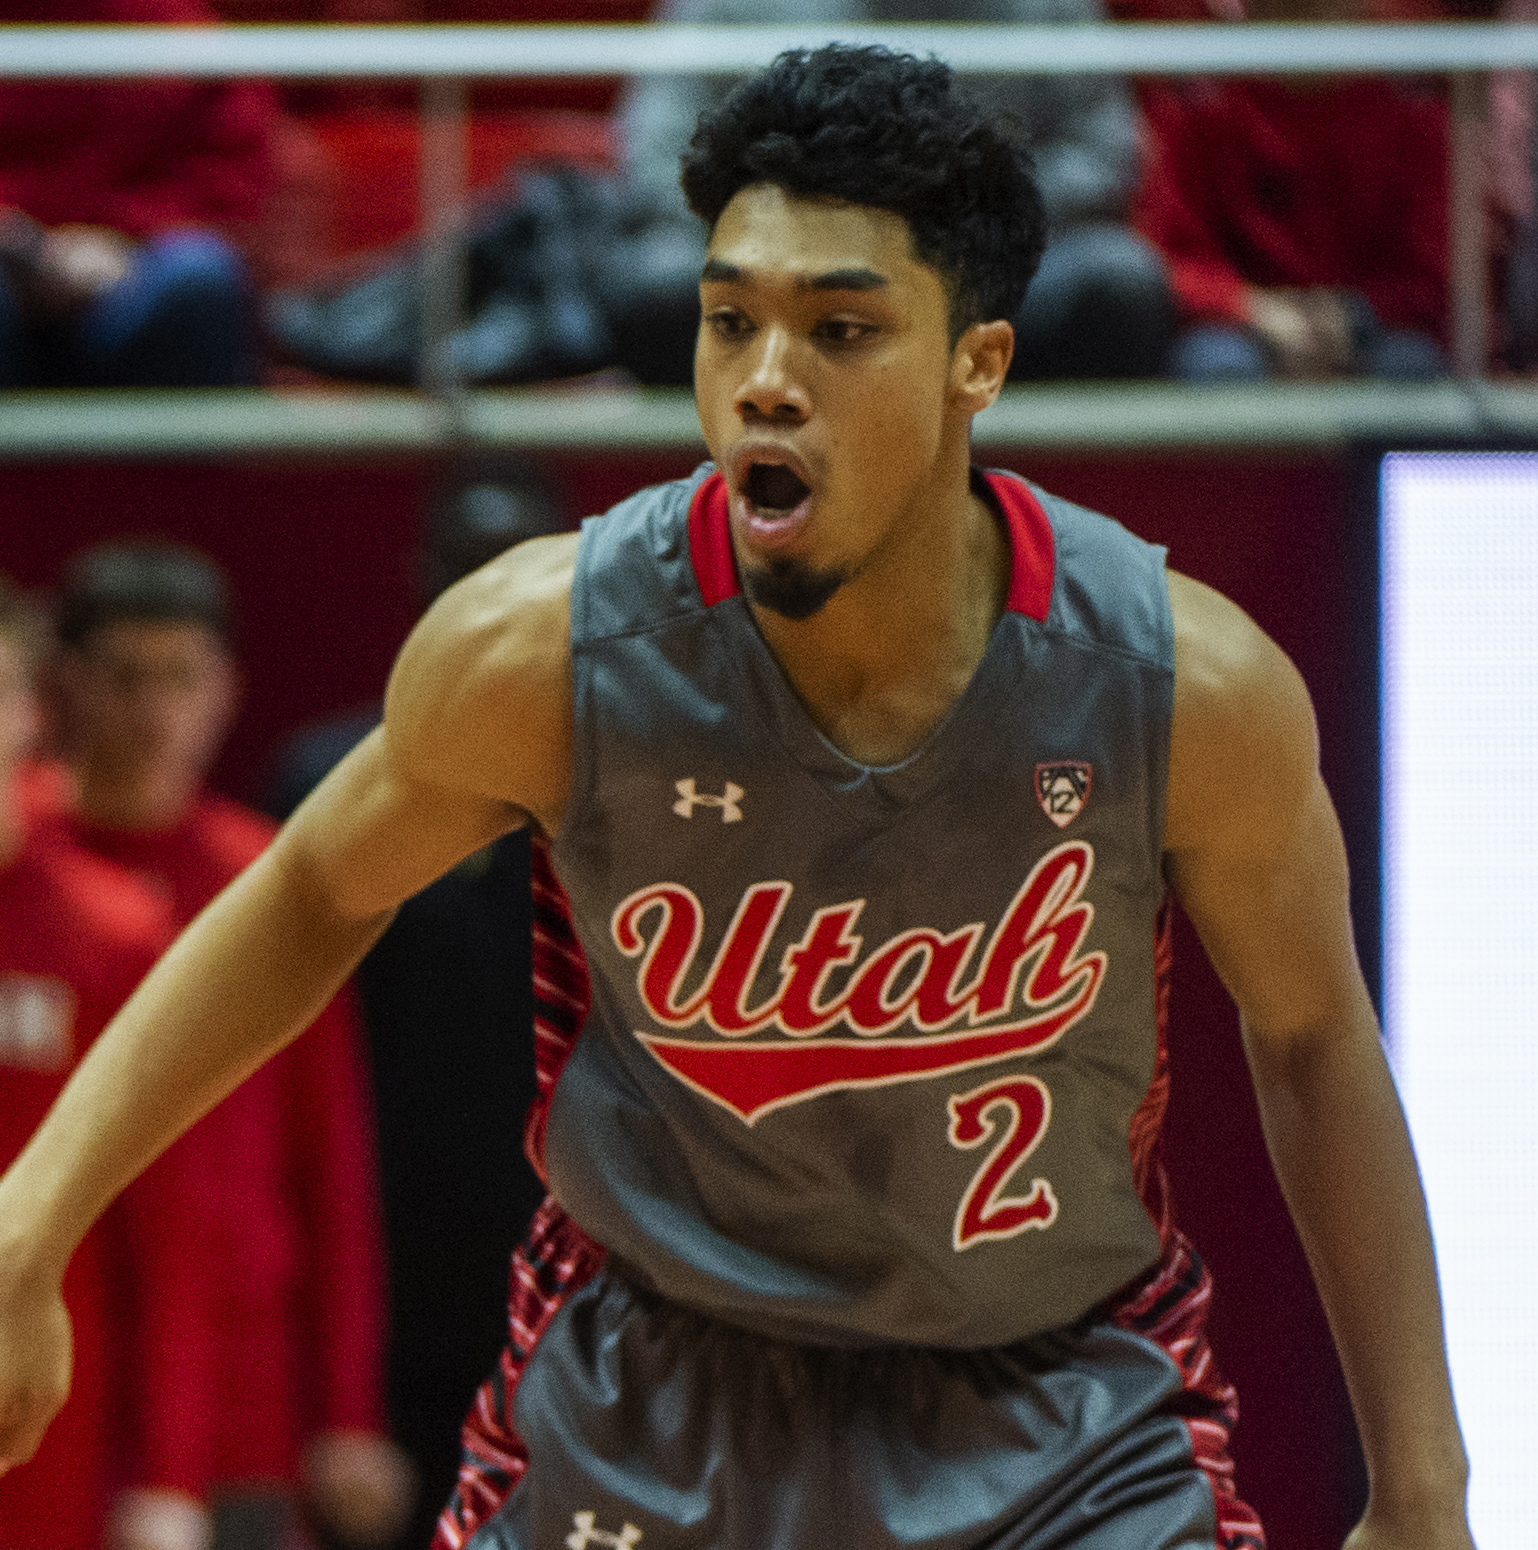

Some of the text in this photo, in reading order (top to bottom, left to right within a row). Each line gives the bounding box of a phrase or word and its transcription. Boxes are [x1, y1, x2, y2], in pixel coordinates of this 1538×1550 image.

[1050, 790, 1077, 814] 12
[612, 841, 1108, 1127] Utah
[946, 1074, 1059, 1252] 2
